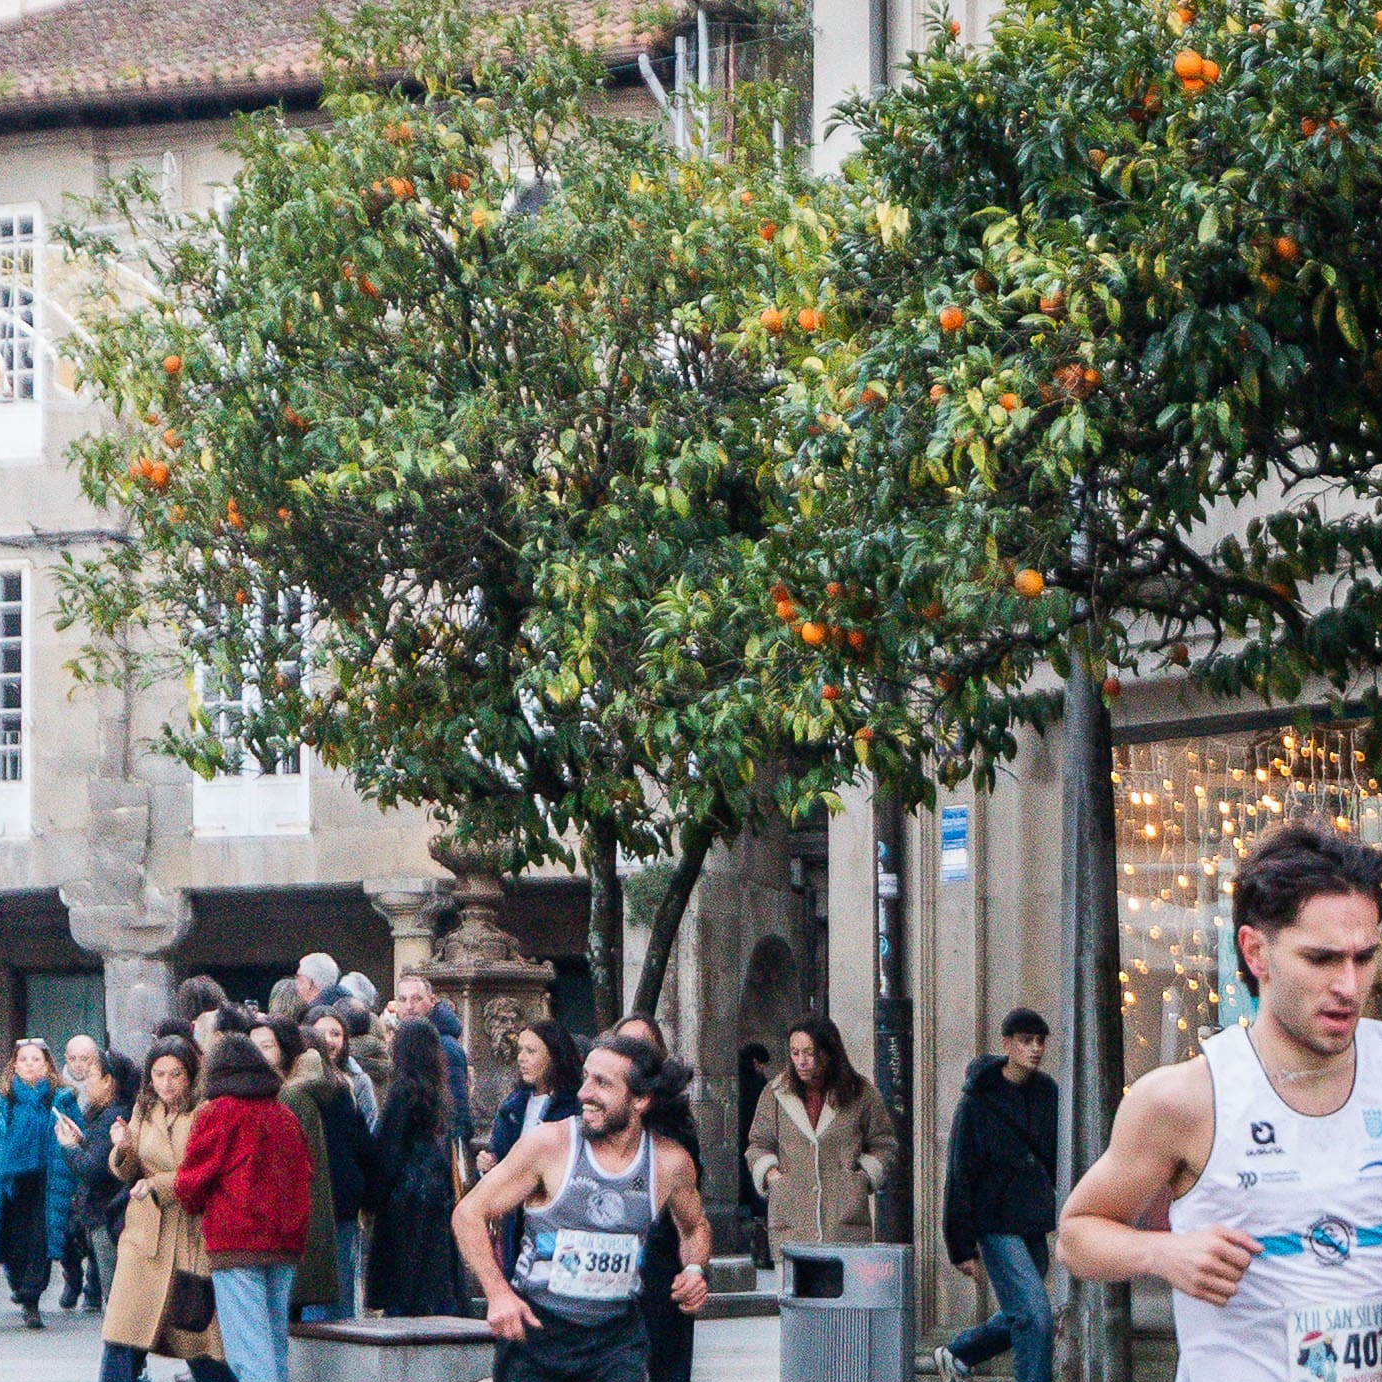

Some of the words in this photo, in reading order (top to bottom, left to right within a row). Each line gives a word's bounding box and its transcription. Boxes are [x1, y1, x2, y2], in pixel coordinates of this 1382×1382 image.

[585, 1251, 631, 1274] 3881
[1295, 1309, 1321, 1332] XLII
[1326, 1308, 1353, 1330] SAN
